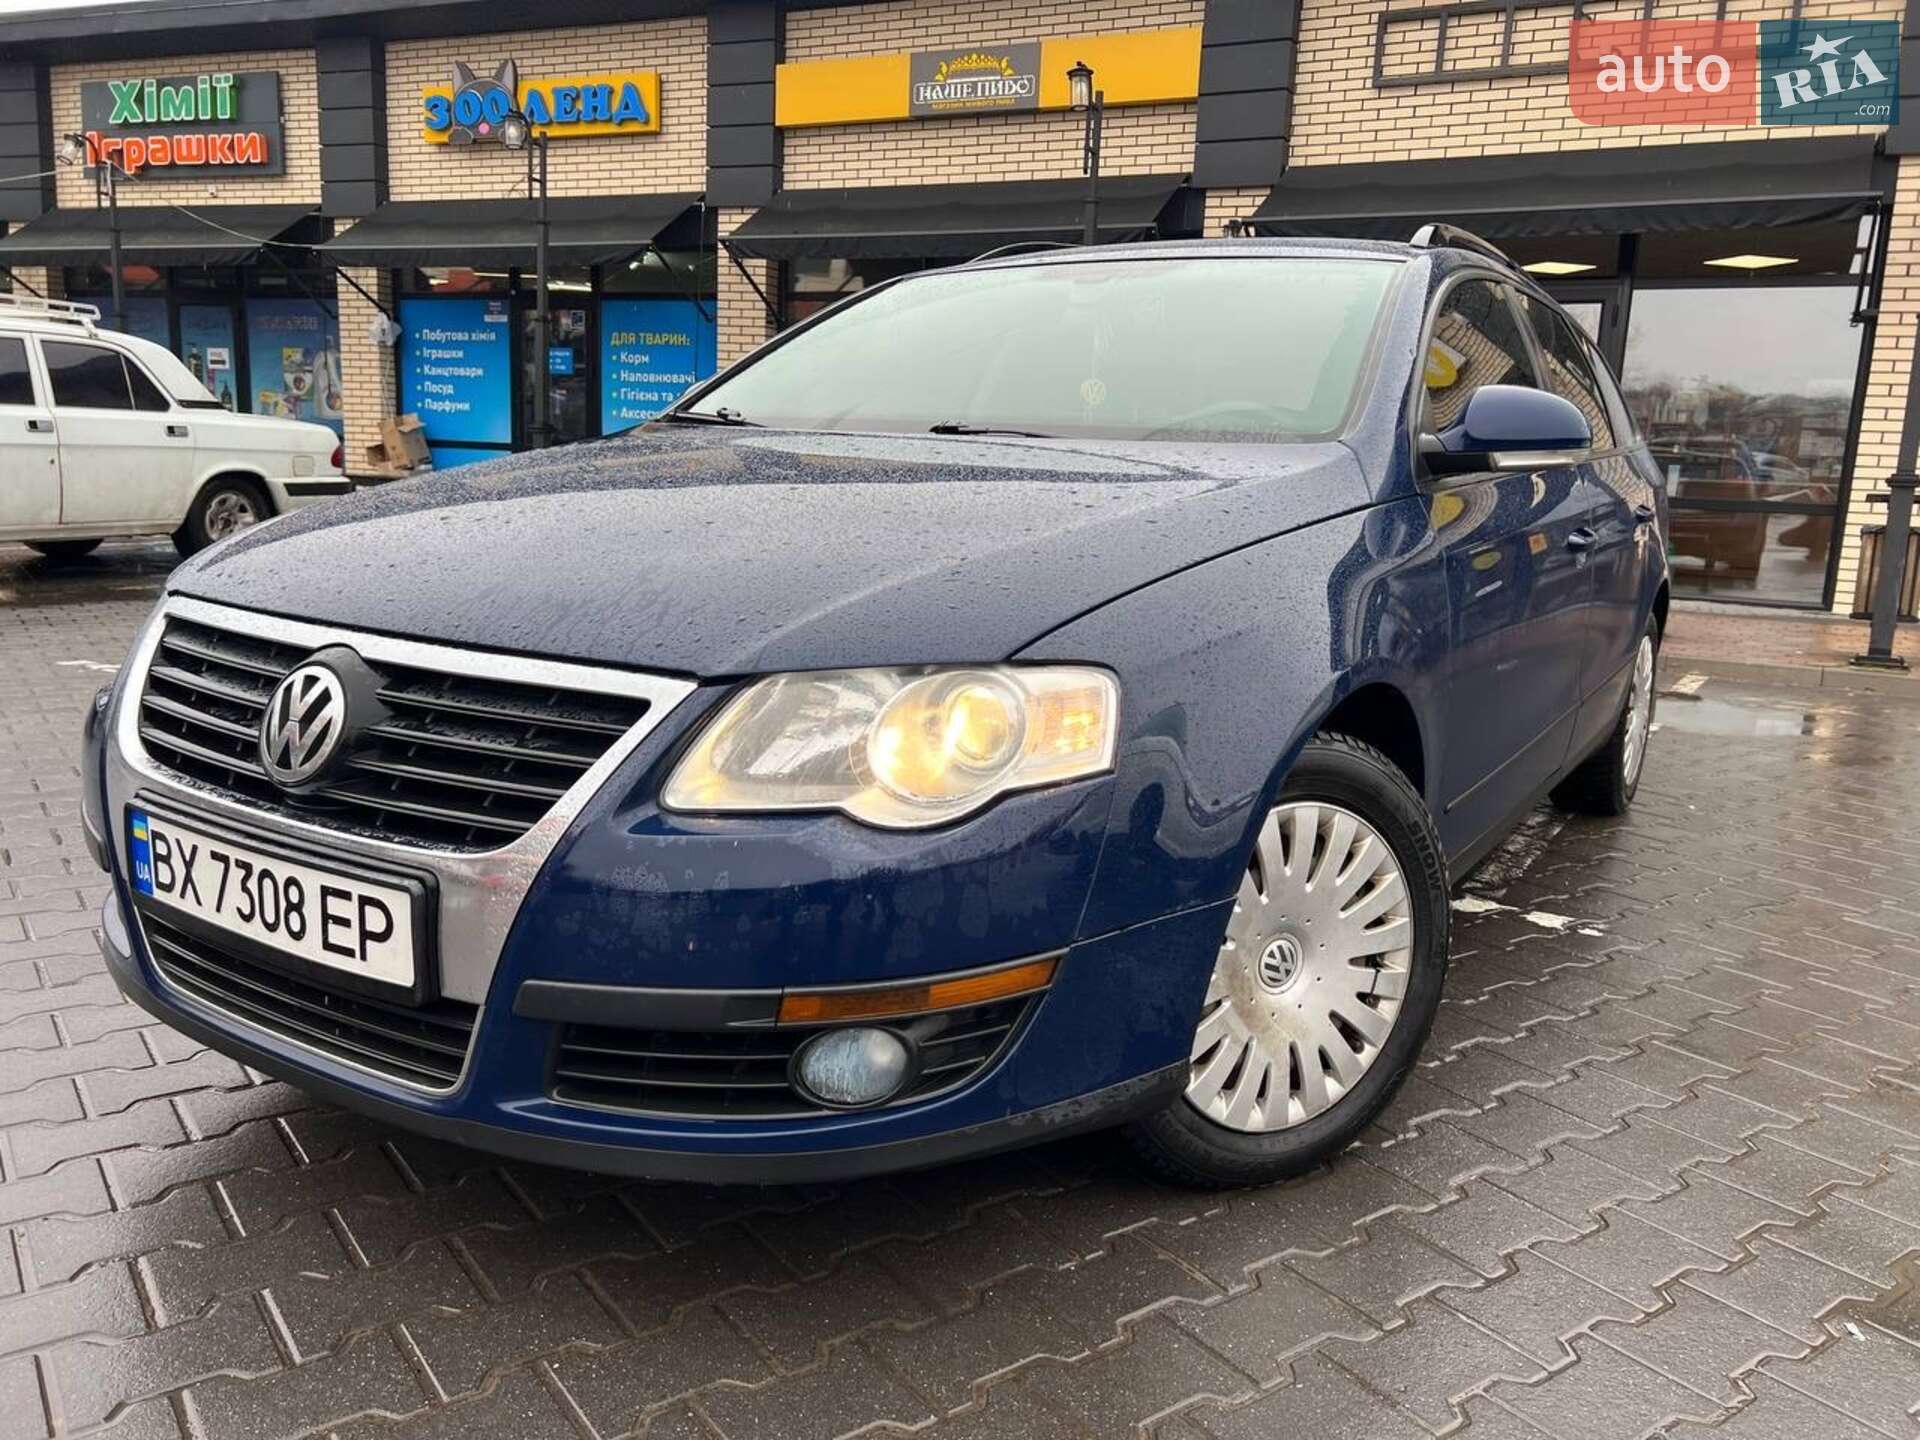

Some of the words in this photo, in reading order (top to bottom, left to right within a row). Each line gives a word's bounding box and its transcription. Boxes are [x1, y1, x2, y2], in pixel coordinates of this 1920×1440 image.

[108, 73, 236, 124] Хімії
[86, 131, 265, 174] Іграшки
[422, 329, 469, 343] Побутова
[471, 330, 496, 341] хімія
[611, 332, 635, 346] ДЛЯ
[640, 333, 690, 346] ТВАРИН:
[423, 348, 464, 360] Іграшки
[620, 352, 649, 365] Корм
[423, 365, 484, 378] Канцтовари
[620, 370, 696, 384] Наповнювачі
[424, 381, 454, 395] Посуд
[620, 388, 658, 401] Гігієна
[661, 392, 673, 401] та
[425, 399, 471, 413] Парфуми
[136, 862, 150, 882] UA
[210, 850, 307, 941] 7308
